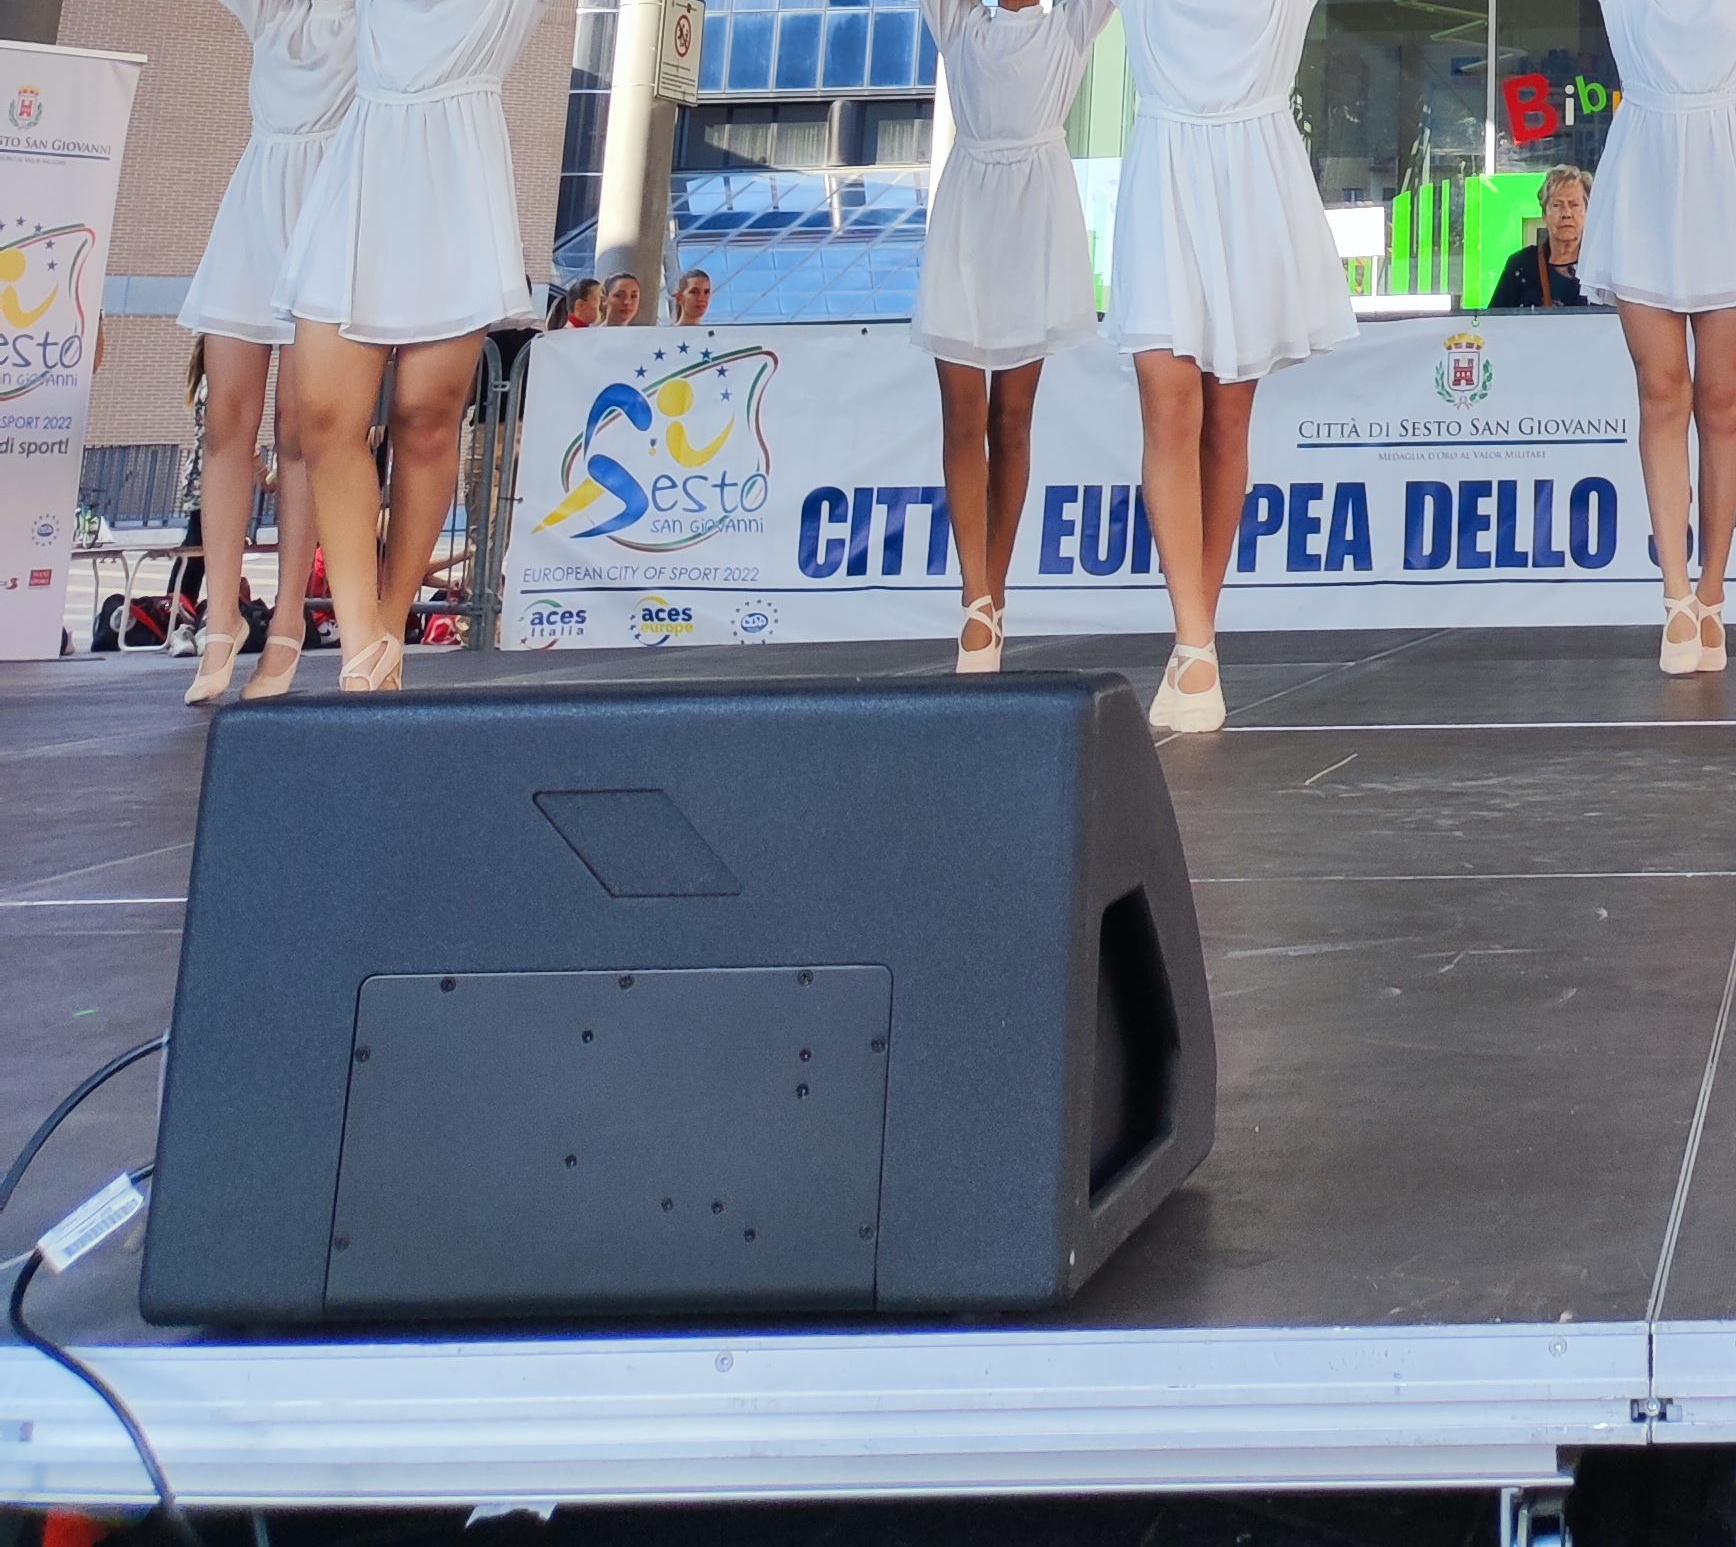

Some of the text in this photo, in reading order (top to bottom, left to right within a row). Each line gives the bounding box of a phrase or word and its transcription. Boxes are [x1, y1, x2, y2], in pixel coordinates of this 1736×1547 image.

[43, 416, 73, 430] 2022
[18, 437, 69, 459] sport!
[797, 485, 950, 579] CITT
[1403, 476, 1618, 571] DELLO
[523, 565, 760, 583] EUROPEAN CITY OF SPORT 2022
[530, 609, 587, 627] aces
[641, 606, 692, 623] aces
[641, 621, 693, 637] europe
